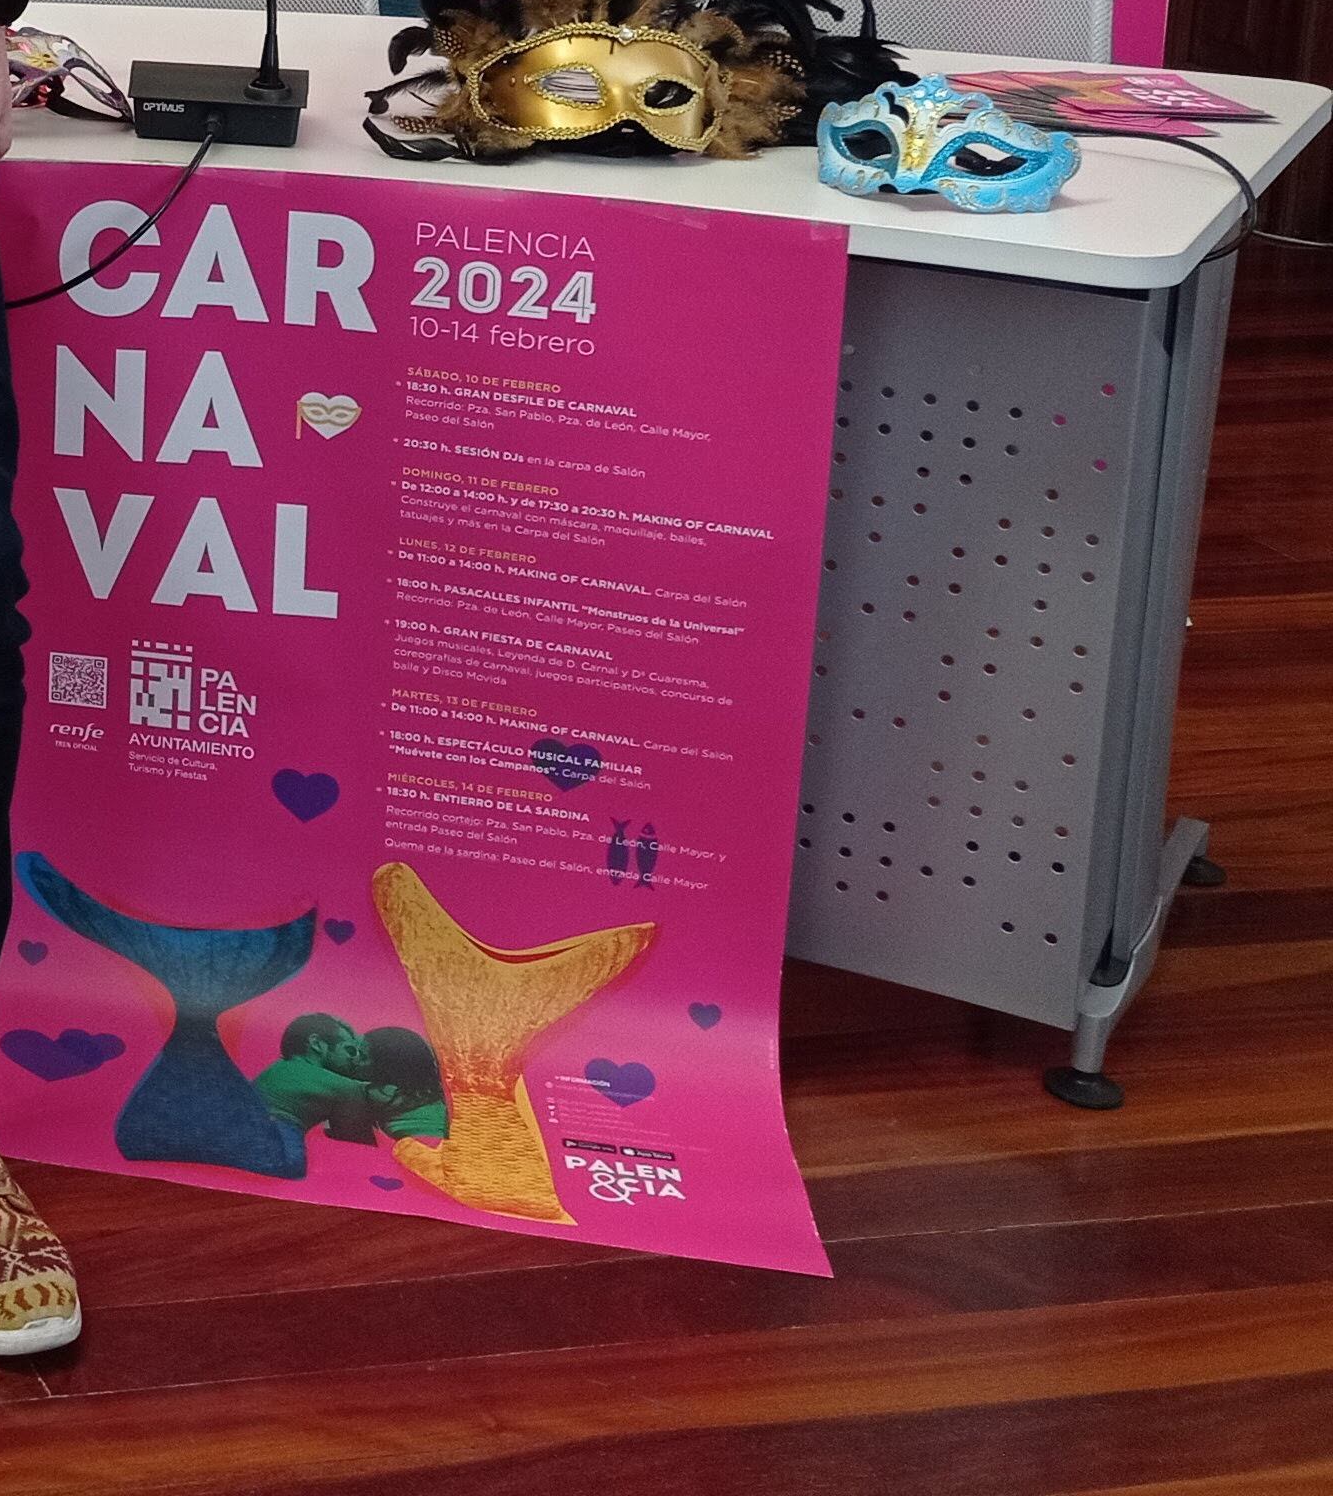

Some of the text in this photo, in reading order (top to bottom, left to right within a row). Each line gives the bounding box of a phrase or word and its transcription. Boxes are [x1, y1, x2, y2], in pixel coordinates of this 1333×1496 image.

[143, 102, 185, 113] OPTIMUS
[415, 222, 596, 262] PALENCIA
[58, 199, 378, 334] CAR
[410, 255, 597, 325] 2024
[409, 315, 596, 356] 10-14 febrero
[407, 367, 561, 393] SÁBADO, 10 DE FEBRERO
[52, 344, 264, 469] NA
[406, 381, 636, 417] 18:30 h. GRAN DESFILE DE CARNAVAL
[402, 438, 645, 477] 20:30 h. SESIÓN DJs en la carpa de Salón
[402, 467, 559, 496] DOMINGO, 11 DE FEBRERO
[401, 480, 417, 490] De
[419, 483, 450, 495] 12:00
[452, 489, 460, 497] a
[462, 489, 495, 501] 14:00
[497, 493, 508, 503] h.
[510, 497, 518, 506] y
[520, 497, 535, 507] de
[537, 499, 569, 512] 17:30
[581, 505, 616, 518] 20:30
[618, 510, 629, 520] h.
[632, 513, 682, 527] MAKING
[684, 519, 703, 529] OF
[705, 522, 774, 539] CARNAVAL
[52, 486, 340, 620] VAL
[397, 550, 414, 560] De
[416, 552, 445, 565] 11:00
[458, 559, 491, 571] 14:00
[493, 563, 505, 574] h.
[507, 566, 557, 581] MAKING
[559, 574, 577, 583] OF
[444, 543, 456, 552] 12
[458, 545, 475, 555] DE
[478, 548, 536, 564] FEBRERO
[396, 577, 428, 589] 18:00
[430, 582, 441, 592] h.
[443, 584, 520, 603] PASACALLES
[522, 597, 579, 612] INFANTIL
[650, 616, 666, 626] de
[669, 618, 680, 628] la
[394, 619, 613, 660] 19:00 h. GRAN FIESTA DE CARNAVAL
[200, 667, 239, 692] PA
[198, 689, 258, 717] LEN
[390, 702, 407, 712] De
[408, 704, 437, 716] 11:00
[440, 710, 448, 718] a
[450, 710, 484, 722] 14:00
[485, 715, 496, 724] h.
[498, 717, 548, 732] MAKING
[550, 725, 569, 735] OF
[446, 695, 458, 705] 13
[460, 697, 477, 708] DE
[480, 701, 537, 717] FEBRERO
[49, 722, 105, 742] renfe
[197, 711, 250, 739] CIA
[128, 732, 256, 760] AYUNTAMIENTO
[128, 750, 219, 771] Servicio de Cultura,
[389, 730, 642, 774] 18:00 h. ESPECTÁCULO MUSICAL FAMILIAR
[444, 753, 467, 762] con
[469, 755, 487, 765] los
[128, 762, 209, 782] Turismo y Fiestas
[386, 786, 589, 821] 18:30 h. ENTIERRO DE LA SARDINA
[461, 782, 474, 791] 14
[476, 784, 493, 794] DE
[496, 787, 553, 802] FEBRERO
[564, 1155, 682, 1183] PALEN
